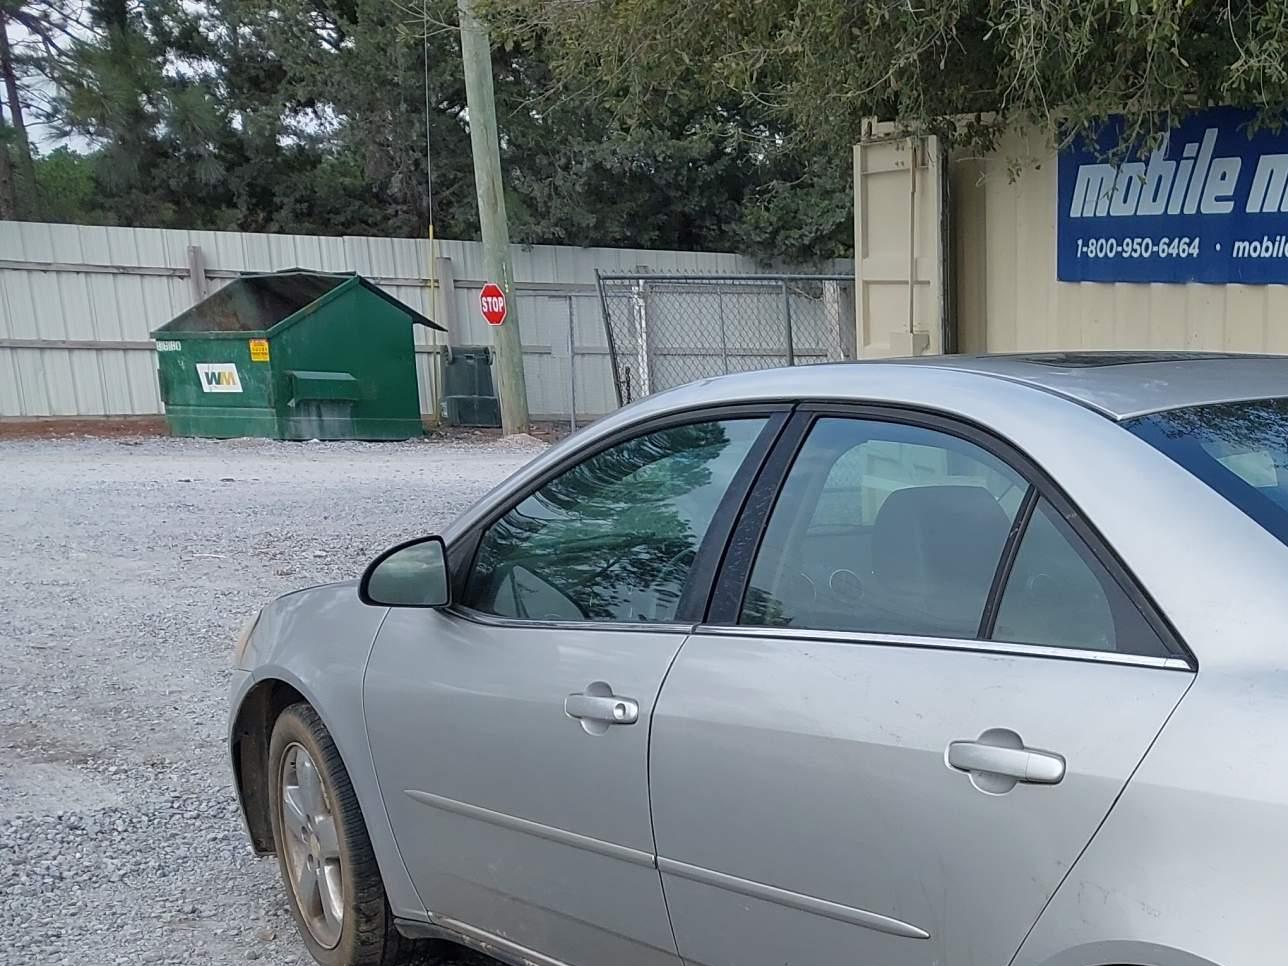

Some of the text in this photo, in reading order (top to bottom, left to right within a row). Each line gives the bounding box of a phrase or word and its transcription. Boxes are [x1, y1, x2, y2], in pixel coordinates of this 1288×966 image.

[1069, 127, 1242, 218] mobile
[1076, 236, 1200, 259] 1-800-950-6464
[481, 296, 504, 313] STOP
[204, 371, 237, 386] WM
